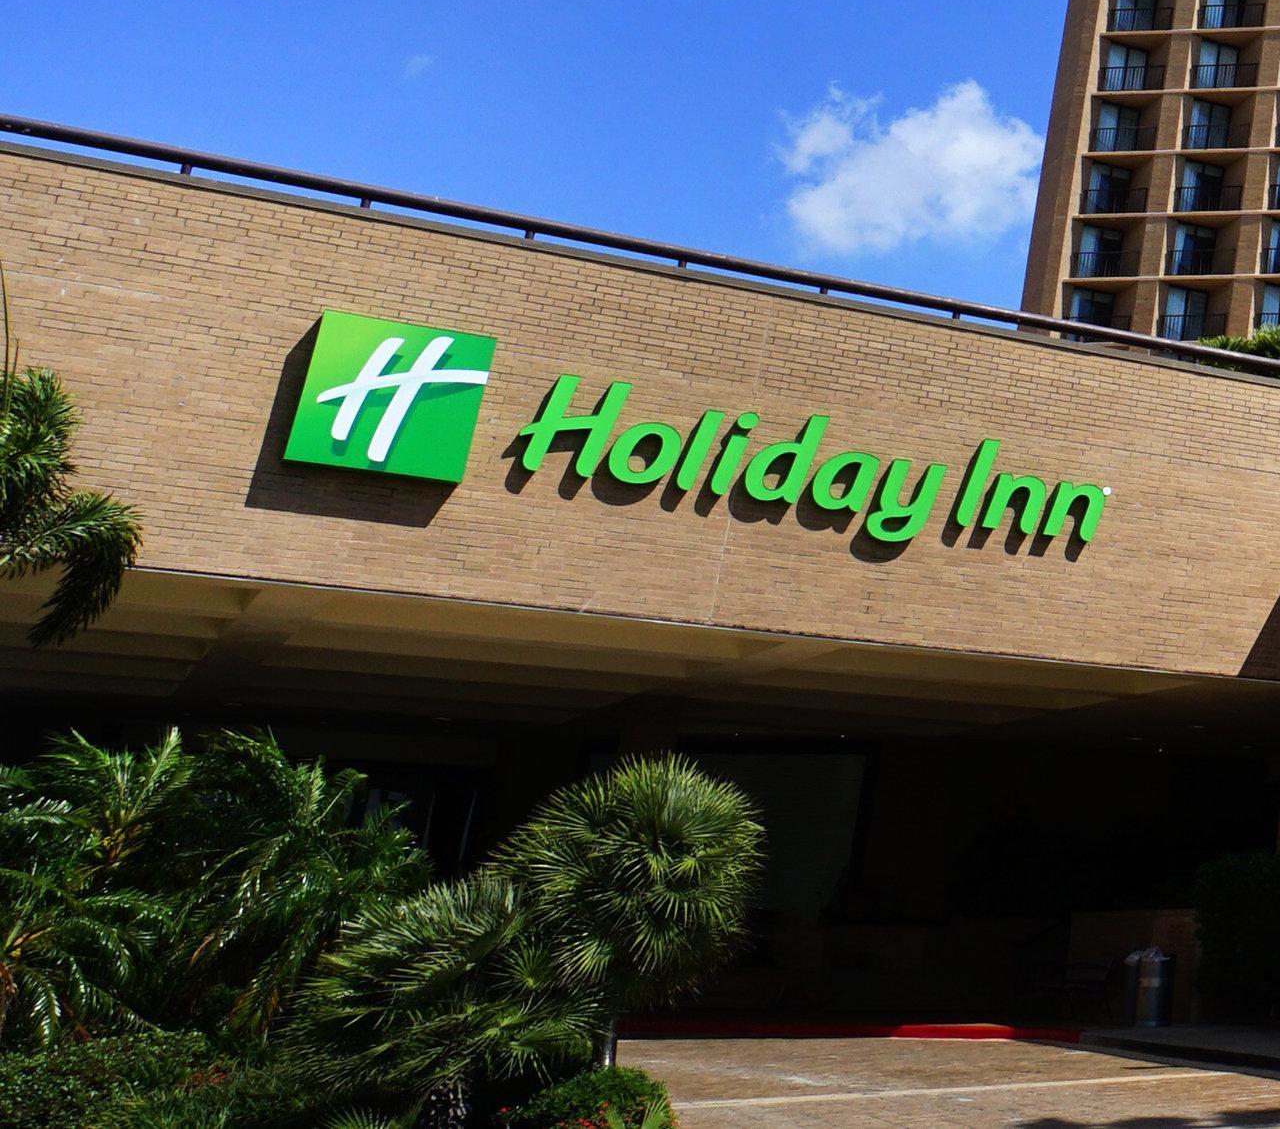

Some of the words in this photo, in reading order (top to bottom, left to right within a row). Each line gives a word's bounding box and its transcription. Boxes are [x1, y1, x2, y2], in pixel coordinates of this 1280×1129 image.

[317, 337, 489, 461] H
[519, 373, 946, 543] Holiday
[956, 438, 1106, 542] Inn
